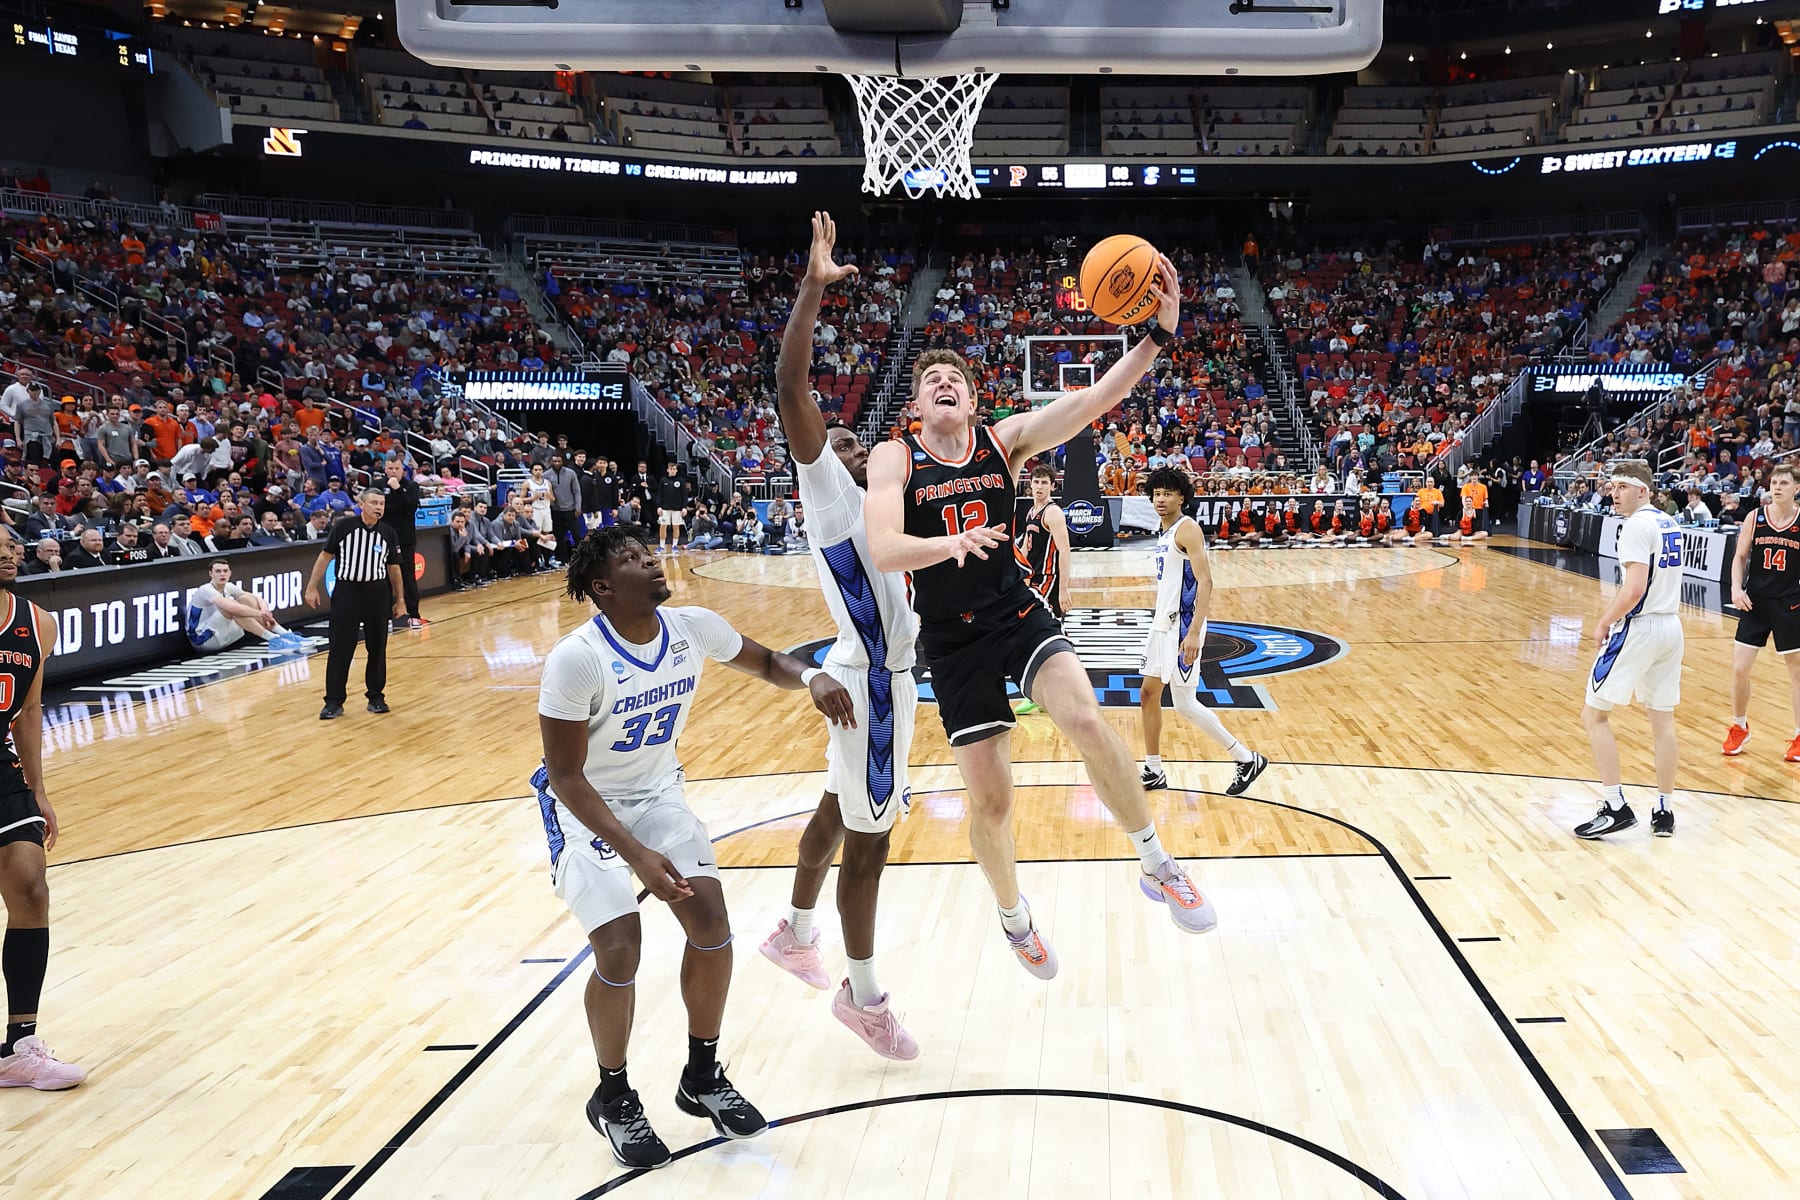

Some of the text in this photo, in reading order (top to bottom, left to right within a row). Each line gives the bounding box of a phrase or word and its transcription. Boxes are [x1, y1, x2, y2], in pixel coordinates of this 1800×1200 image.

[15, 35, 25, 45] 75
[28, 31, 49, 44] FINAL
[53, 31, 78, 45] XAVIER
[54, 42, 77, 55] TEXAS
[470, 150, 797, 184] PRINCETON TIGERS VS CREIGHTON BLUEJAYS
[1564, 143, 1712, 171] SWEET SIXTEEN
[915, 474, 1005, 506] PRINCETON
[941, 499, 988, 536] 12
[1069, 508, 1092, 517] MARCH
[1071, 516, 1103, 524] MADNESS
[130, 550, 148, 560] POSS
[1658, 532, 1681, 568] 55
[1755, 535, 1800, 550] PRINCETON
[1763, 548, 1786, 571] 14
[252, 571, 303, 611] FOUR
[90, 600, 126, 648] TO
[133, 591, 180, 640] THE
[612, 675, 695, 714] CREIGHTON
[609, 703, 682, 752] 33
